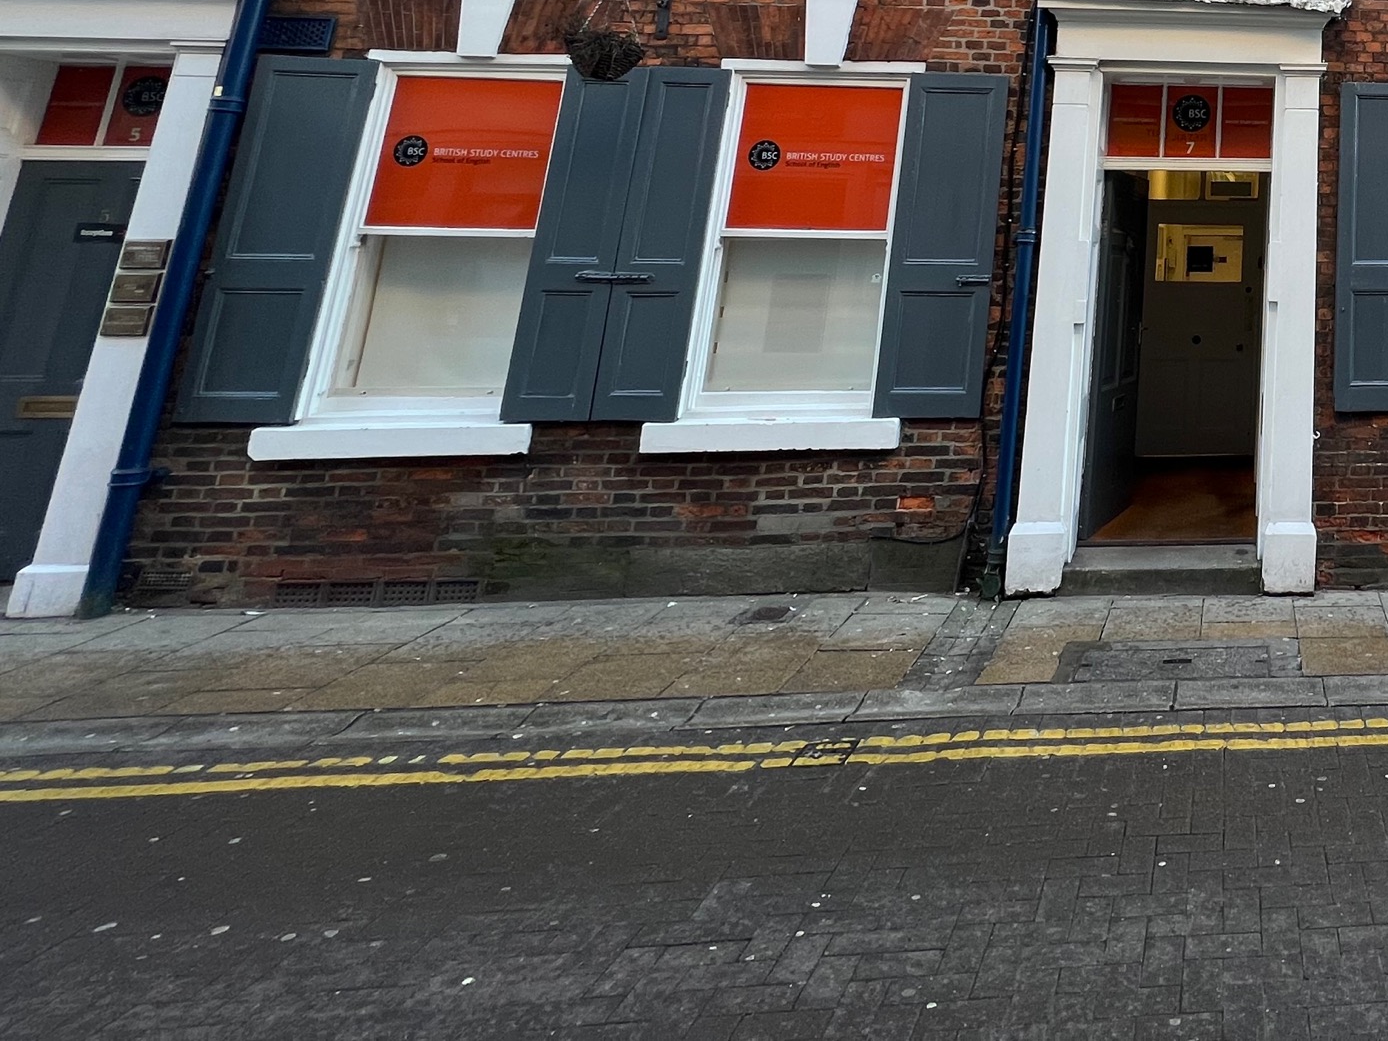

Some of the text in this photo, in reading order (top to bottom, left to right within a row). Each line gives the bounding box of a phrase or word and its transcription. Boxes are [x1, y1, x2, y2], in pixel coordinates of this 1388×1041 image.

[141, 91, 164, 102] BSC
[1188, 108, 1207, 119] BSC
[128, 127, 142, 141] 5
[407, 146, 425, 156] BSC
[1185, 141, 1195, 154] 7
[433, 147, 539, 159] BRITISH STUDY CENTRES
[761, 151, 778, 160] BSC
[786, 152, 885, 162] BRITISH STUDY CENTRES
[465, 158, 491, 166] English
[816, 161, 841, 169] English
